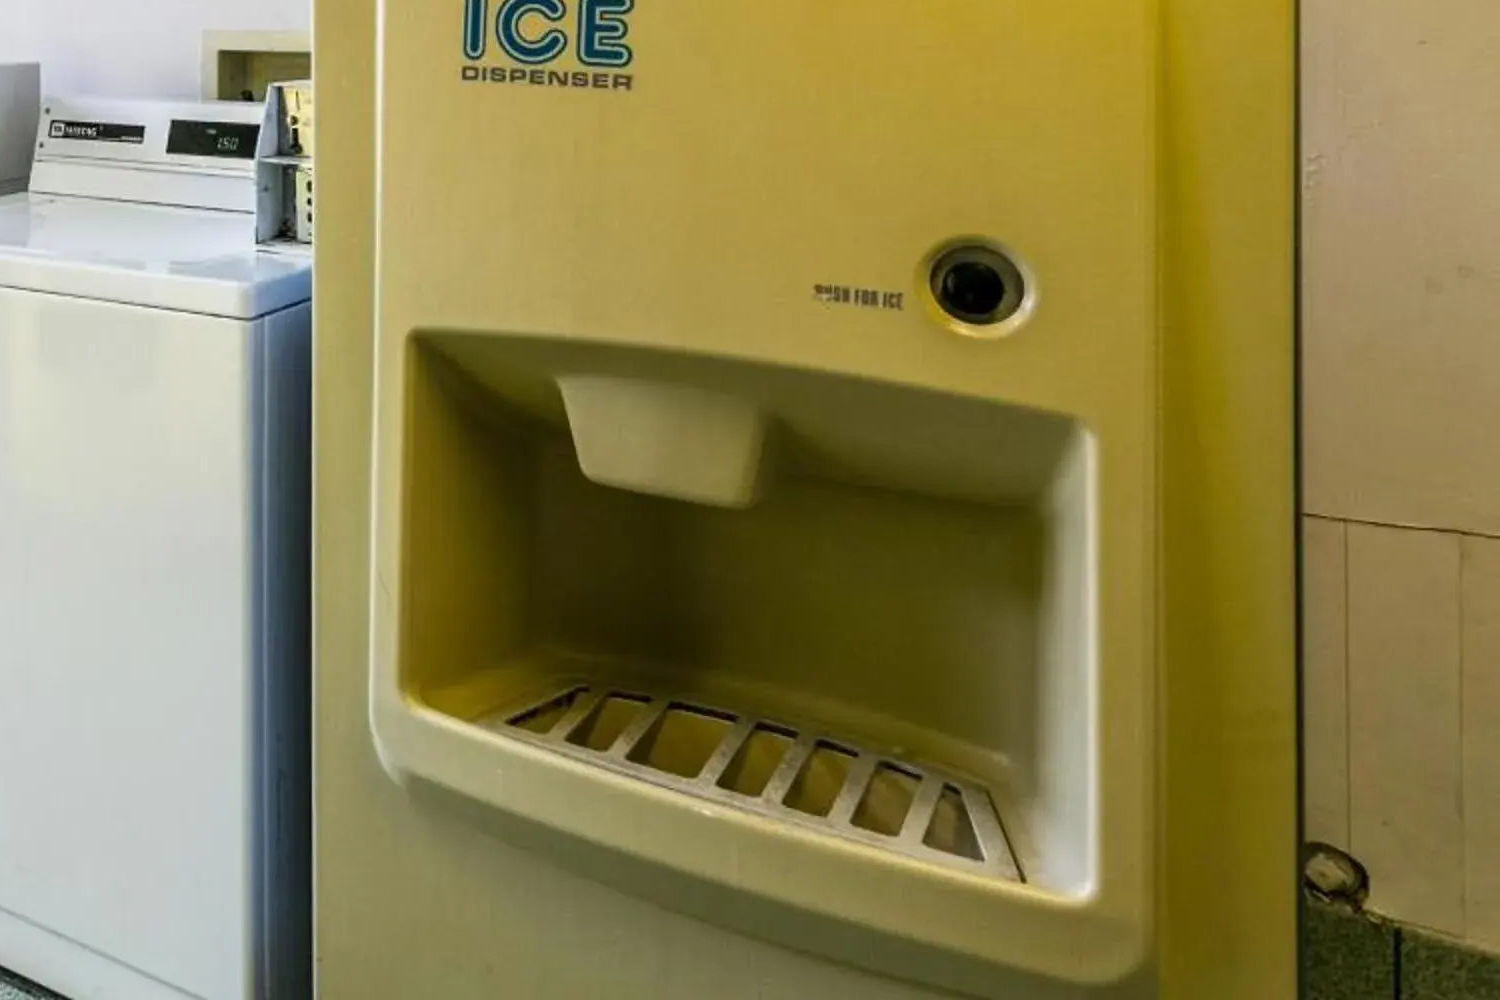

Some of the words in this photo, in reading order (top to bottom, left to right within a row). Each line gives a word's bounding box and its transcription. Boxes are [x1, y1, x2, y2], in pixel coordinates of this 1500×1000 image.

[461, 65, 635, 91] DISPENSER
[854, 288, 878, 306] FOR
[882, 291, 904, 312] ICE
